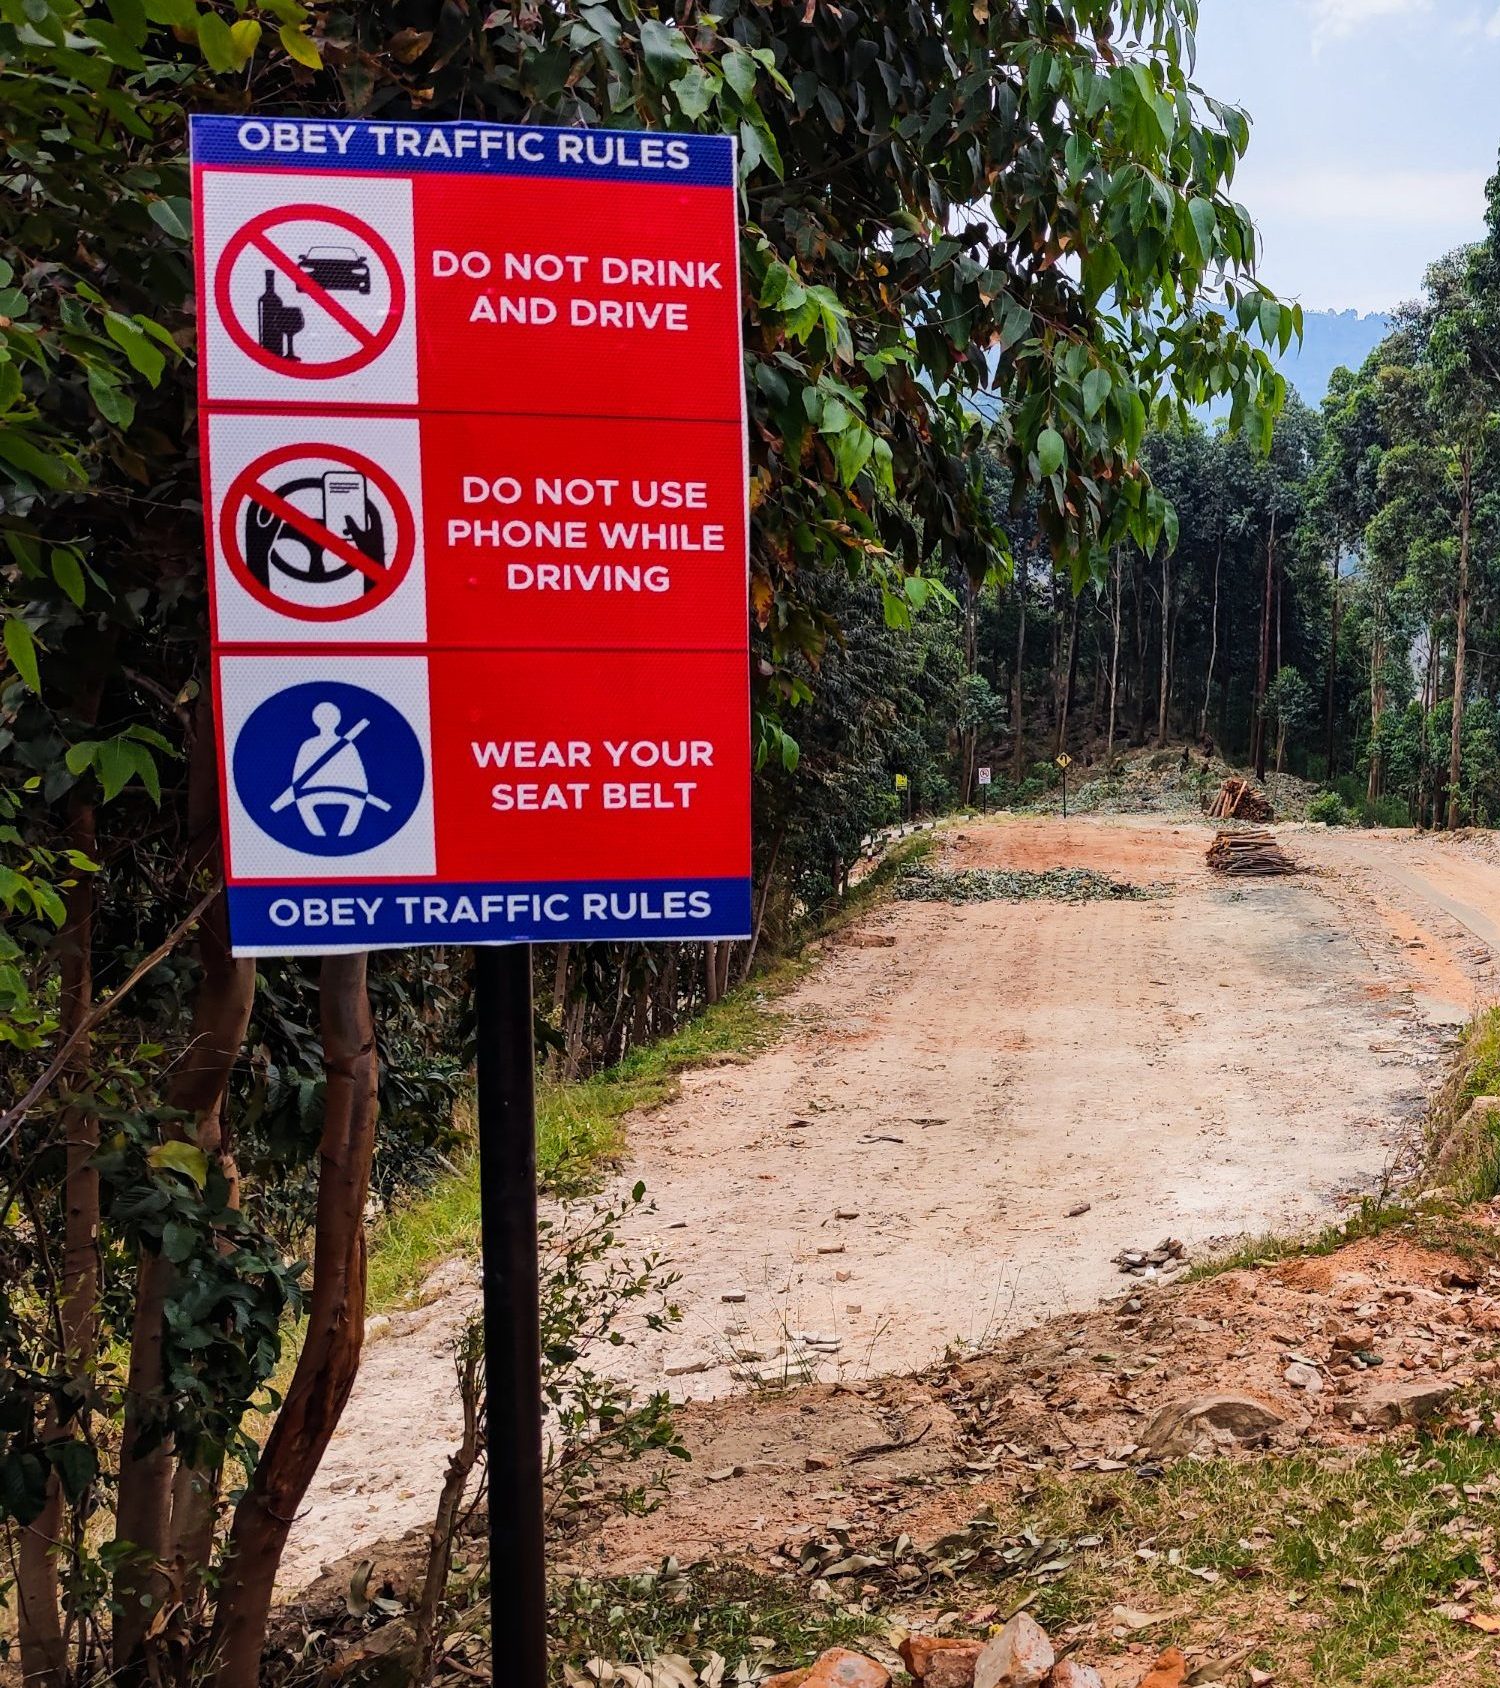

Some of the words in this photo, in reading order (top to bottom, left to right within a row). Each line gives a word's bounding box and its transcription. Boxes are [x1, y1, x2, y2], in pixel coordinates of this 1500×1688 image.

[237, 121, 357, 154] OBEY
[367, 126, 546, 161] TRAFFIC
[558, 134, 691, 169] RULES
[432, 250, 491, 279] DO
[505, 253, 589, 283] NOT
[602, 257, 722, 289] DRINK
[469, 295, 557, 325] AND
[570, 299, 689, 331] DRIVE
[463, 476, 522, 504] DO
[535, 478, 619, 506] NOT
[632, 480, 708, 508] USE
[448, 519, 587, 549] PHONE
[599, 522, 725, 551] WHILE
[507, 563, 670, 592] DRIVING
[471, 741, 591, 768] WEAR
[603, 740, 714, 767] YOUR
[492, 783, 590, 811] SEAT
[603, 782, 697, 809] BELT
[268, 897, 383, 927] OBEY
[395, 893, 570, 924] TRAFFIC
[583, 890, 712, 920] RULES
